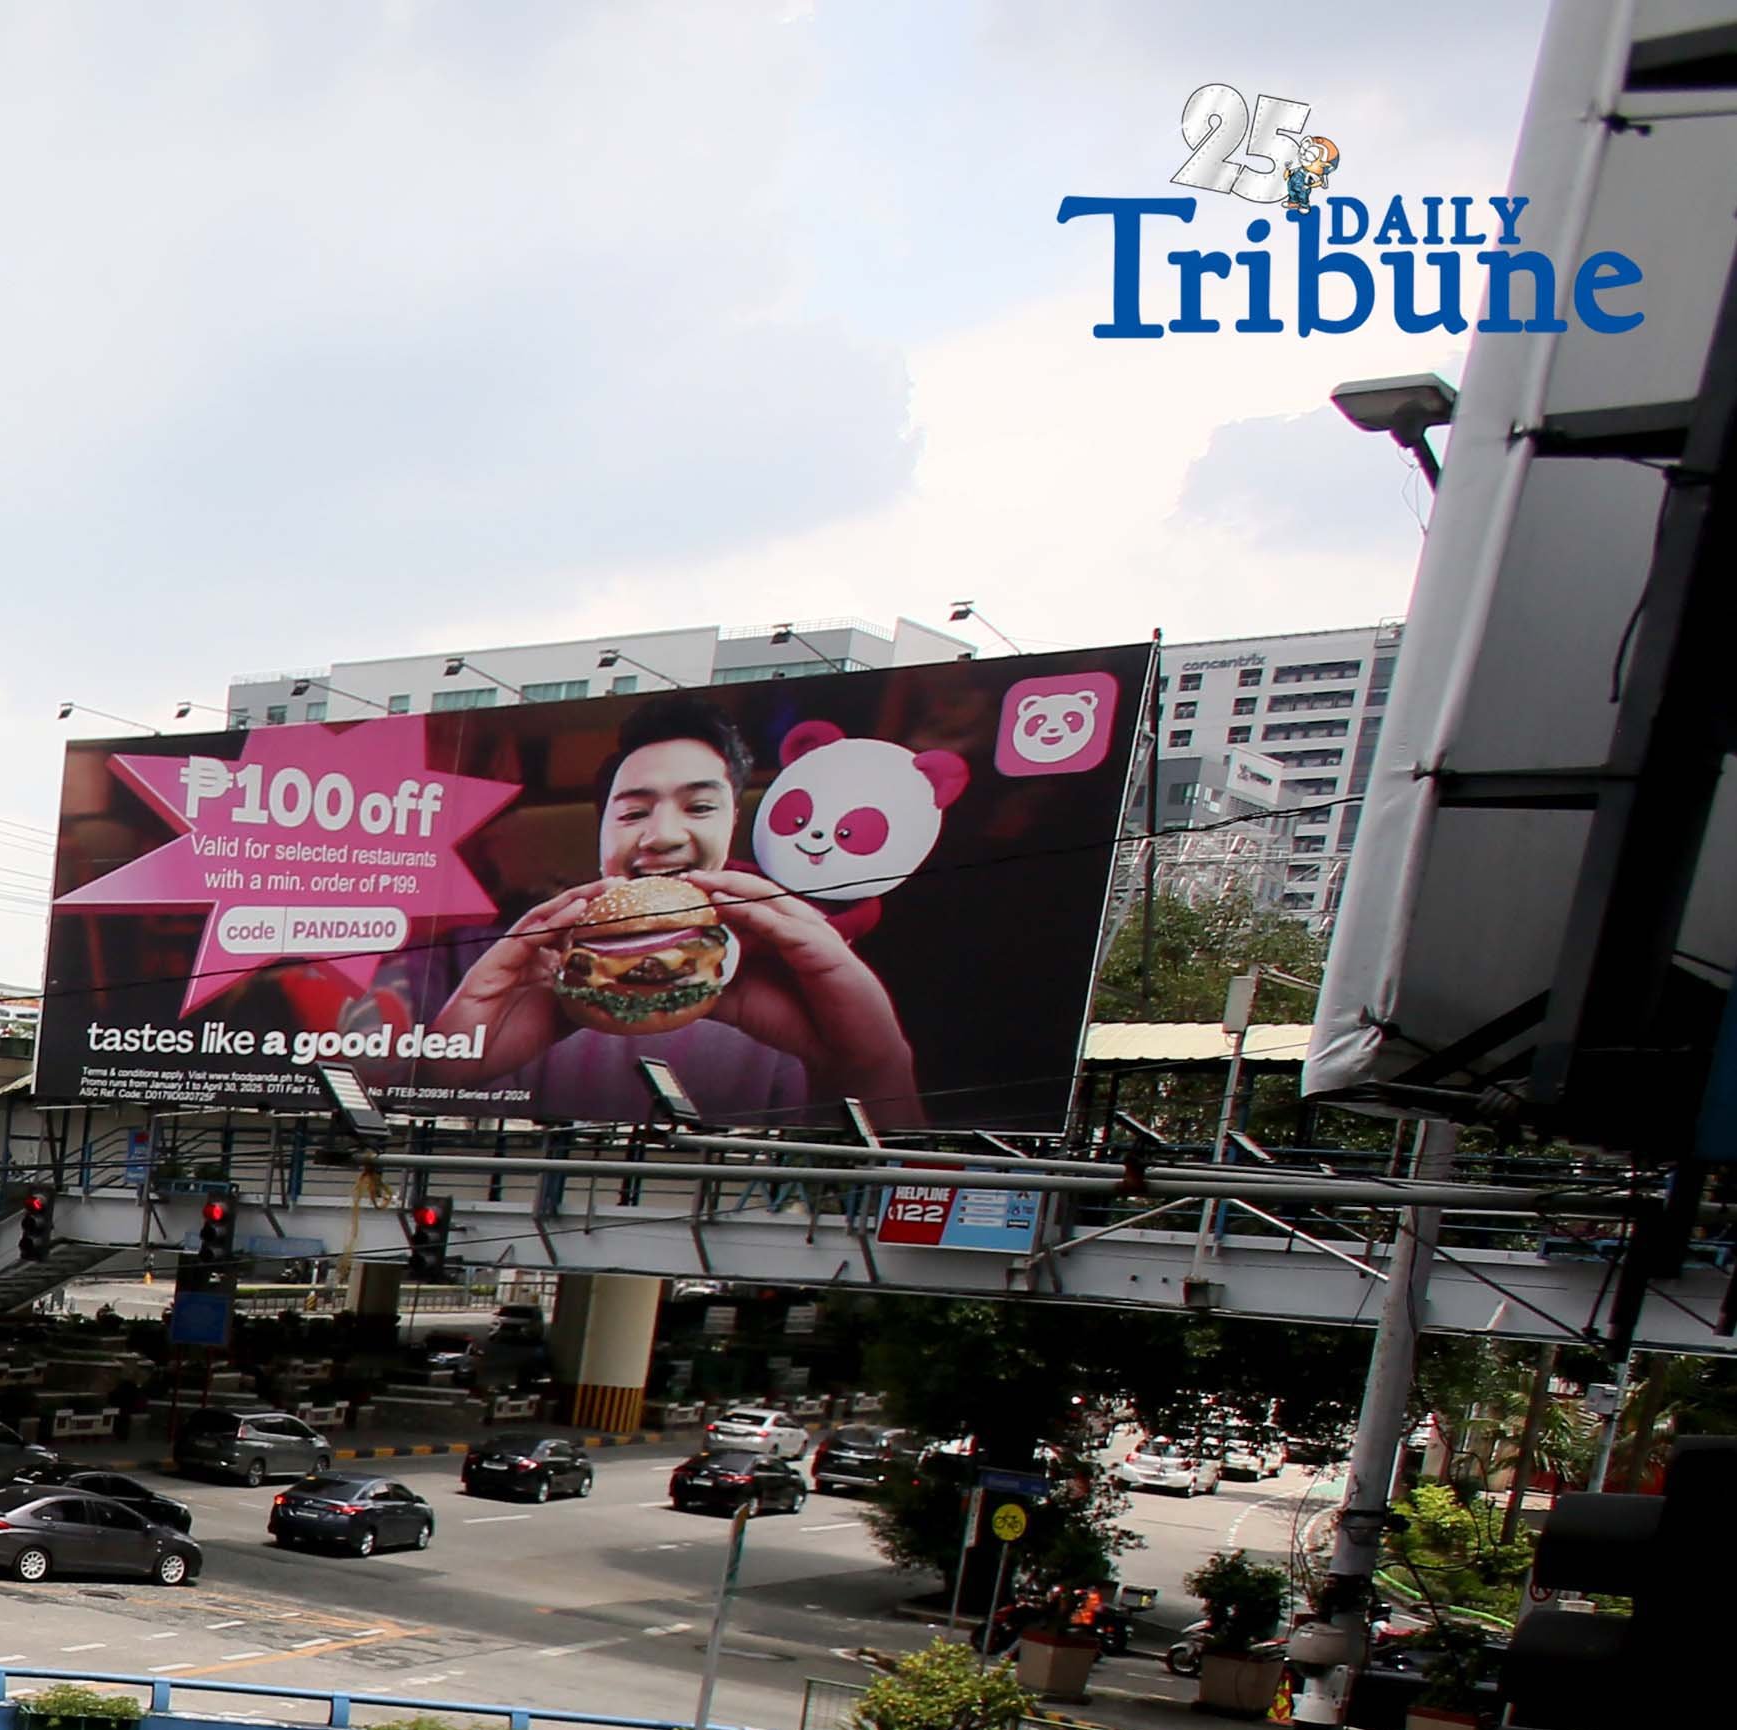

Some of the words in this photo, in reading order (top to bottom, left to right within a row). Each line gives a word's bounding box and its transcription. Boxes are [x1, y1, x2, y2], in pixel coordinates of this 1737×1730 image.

[1182, 653, 1266, 671] concentrix
[359, 780, 444, 837] off
[191, 834, 239, 858] Valid
[245, 838, 271, 859] for
[275, 842, 347, 864] selected
[352, 848, 437, 868] restaurants
[204, 868, 244, 890] with
[250, 874, 262, 890] a
[267, 871, 305, 891] min.
[311, 873, 354, 893] order
[359, 874, 376, 893] of
[227, 920, 276, 940] code
[292, 920, 396, 938] PANDA100
[87, 1022, 194, 1053] tastes
[201, 1022, 255, 1054] like
[262, 1031, 288, 1056] a
[291, 1024, 393, 1065] good
[396, 1024, 487, 1059] deal
[82, 1066, 107, 1076] Terms
[109, 1067, 116, 1077] &
[117, 1068, 159, 1079] conditions
[188, 1070, 207, 1080] Visit
[79, 1088, 99, 1097] ASC
[81, 1077, 107, 1087] Promo
[109, 1078, 127, 1088] runs
[129, 1079, 147, 1088] from
[149, 1080, 183, 1091] January
[192, 1081, 201, 1090] to
[202, 1082, 223, 1092] April
[267, 1083, 285, 1093] DTI
[286, 1084, 305, 1094] Fair
[457, 1089, 489, 1100] Series
[491, 1090, 504, 1100] of
[504, 1090, 531, 1101] 2024
[895, 1185, 952, 1202] HELPLINE
[896, 1203, 945, 1224] 122
